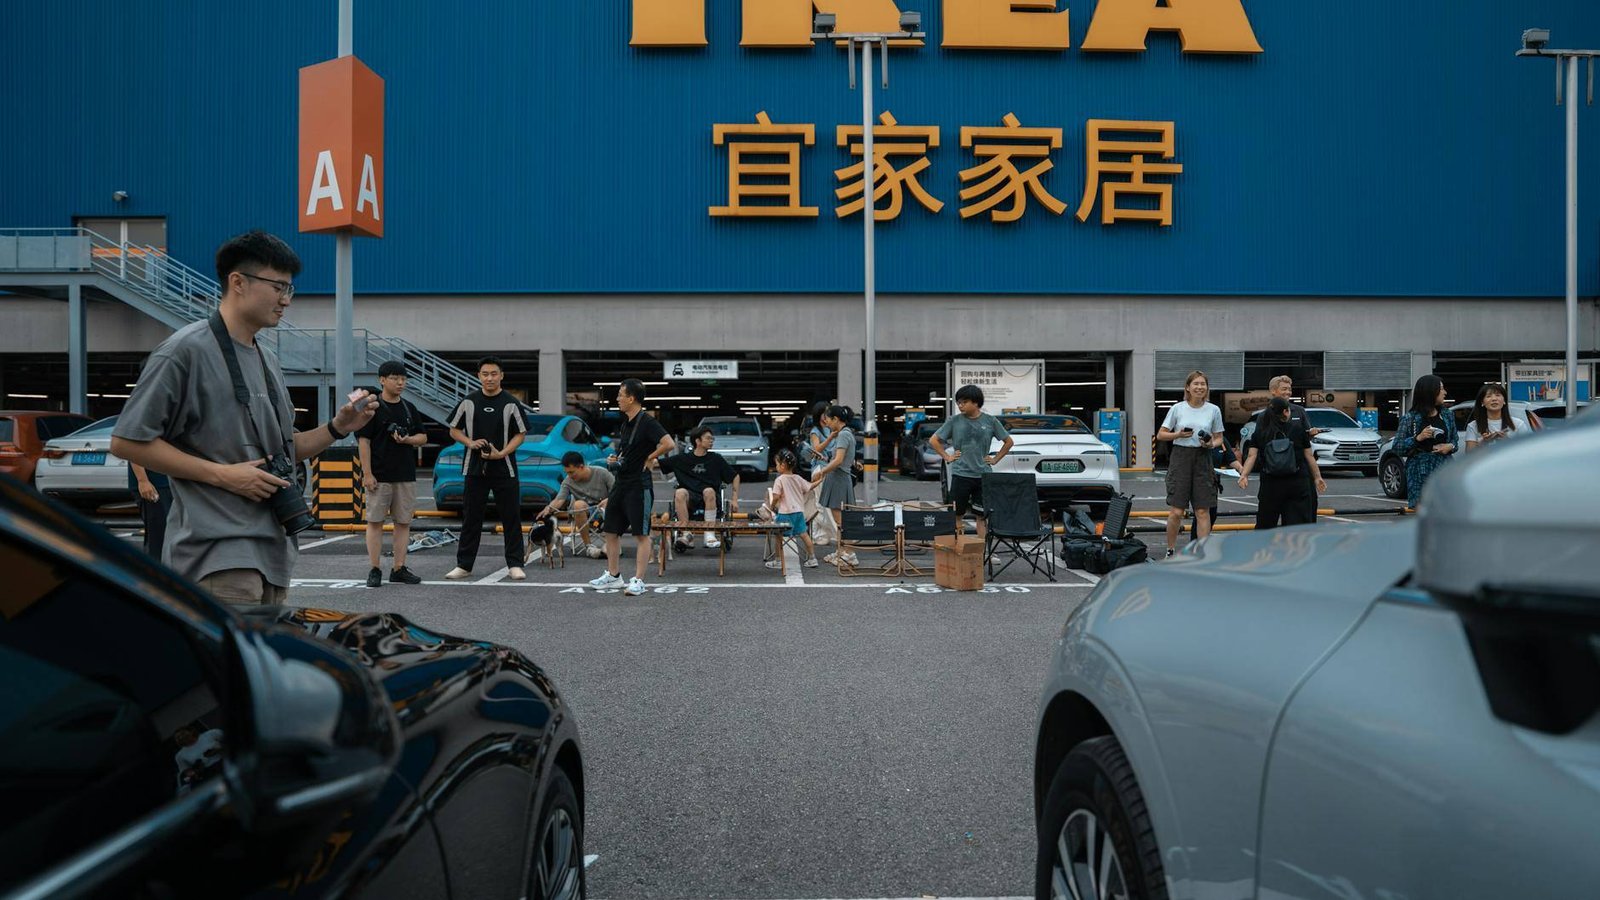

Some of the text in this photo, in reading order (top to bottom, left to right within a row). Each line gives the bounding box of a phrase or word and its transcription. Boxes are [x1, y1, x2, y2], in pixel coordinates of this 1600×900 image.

[305, 149, 344, 216] A
[356, 153, 380, 221] A
[707, 110, 1184, 227] 宜家家居
